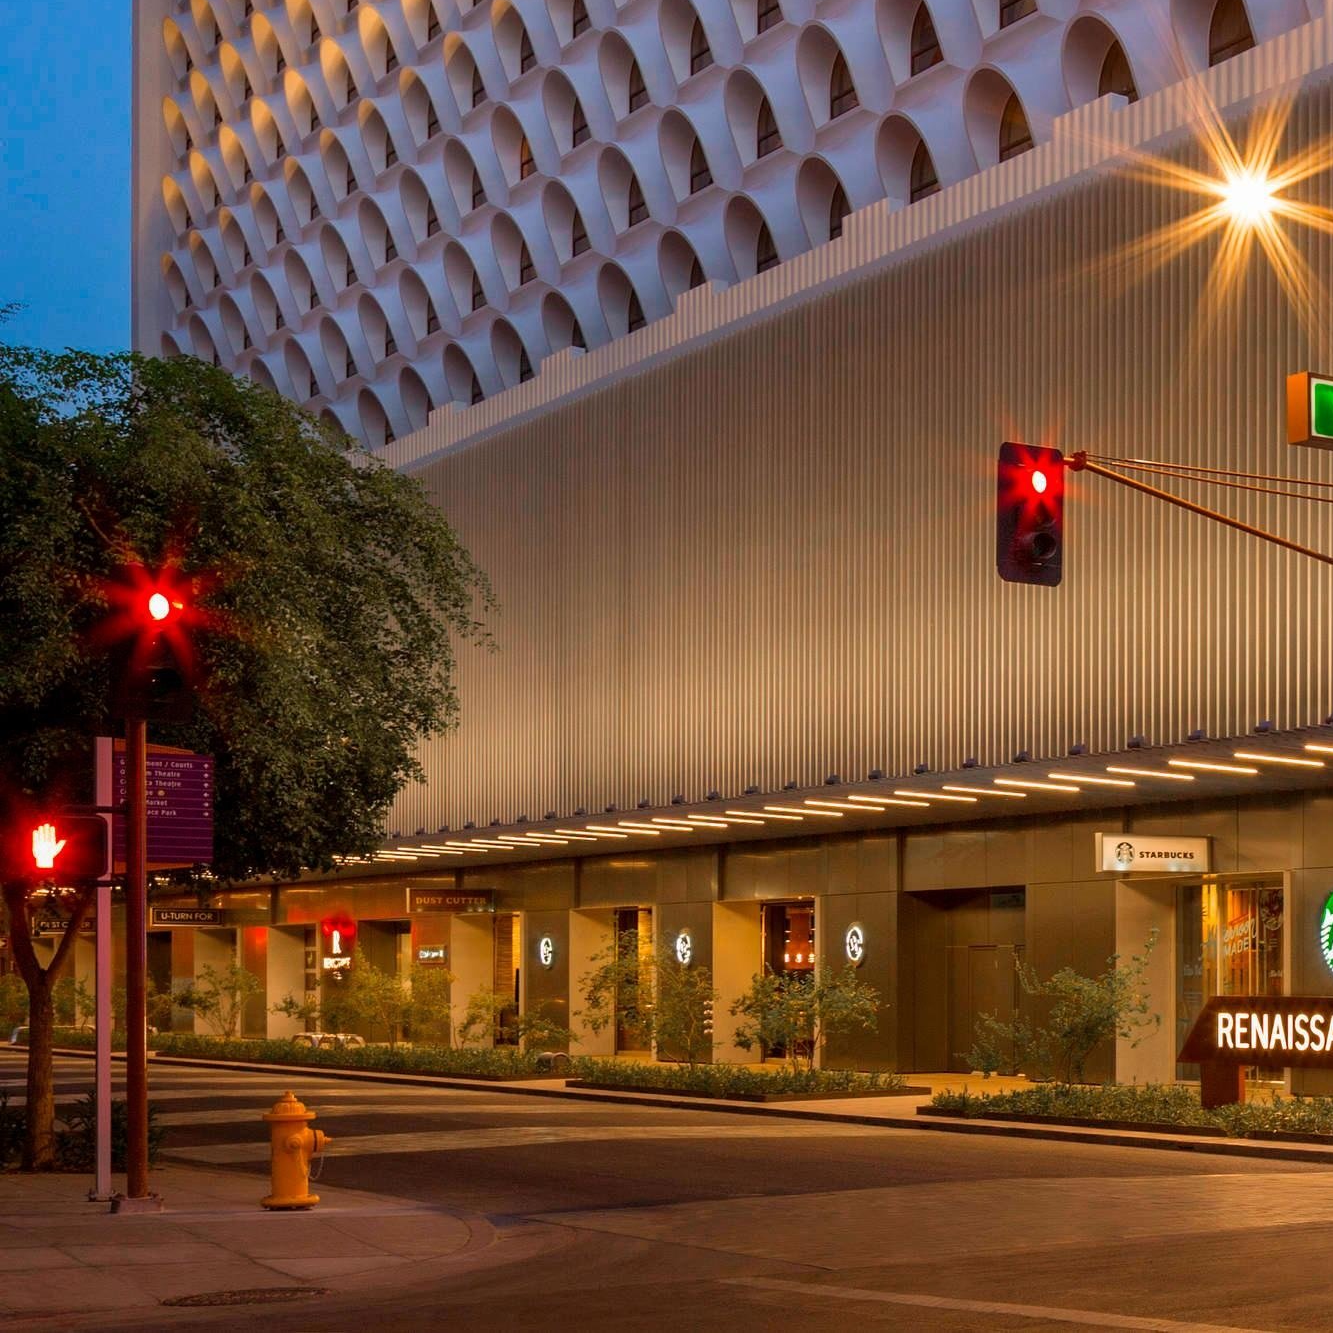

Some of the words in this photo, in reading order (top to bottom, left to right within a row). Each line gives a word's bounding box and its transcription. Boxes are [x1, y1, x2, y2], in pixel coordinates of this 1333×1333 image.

[155, 770, 180, 778] Theatre
[155, 779, 181, 787] Theatre
[1138, 851, 1194, 860] STARBUCKS
[416, 897, 442, 905] DUST
[446, 897, 486, 905] CUTTER
[161, 912, 193, 921] U-TURN
[194, 912, 213, 921] FOR
